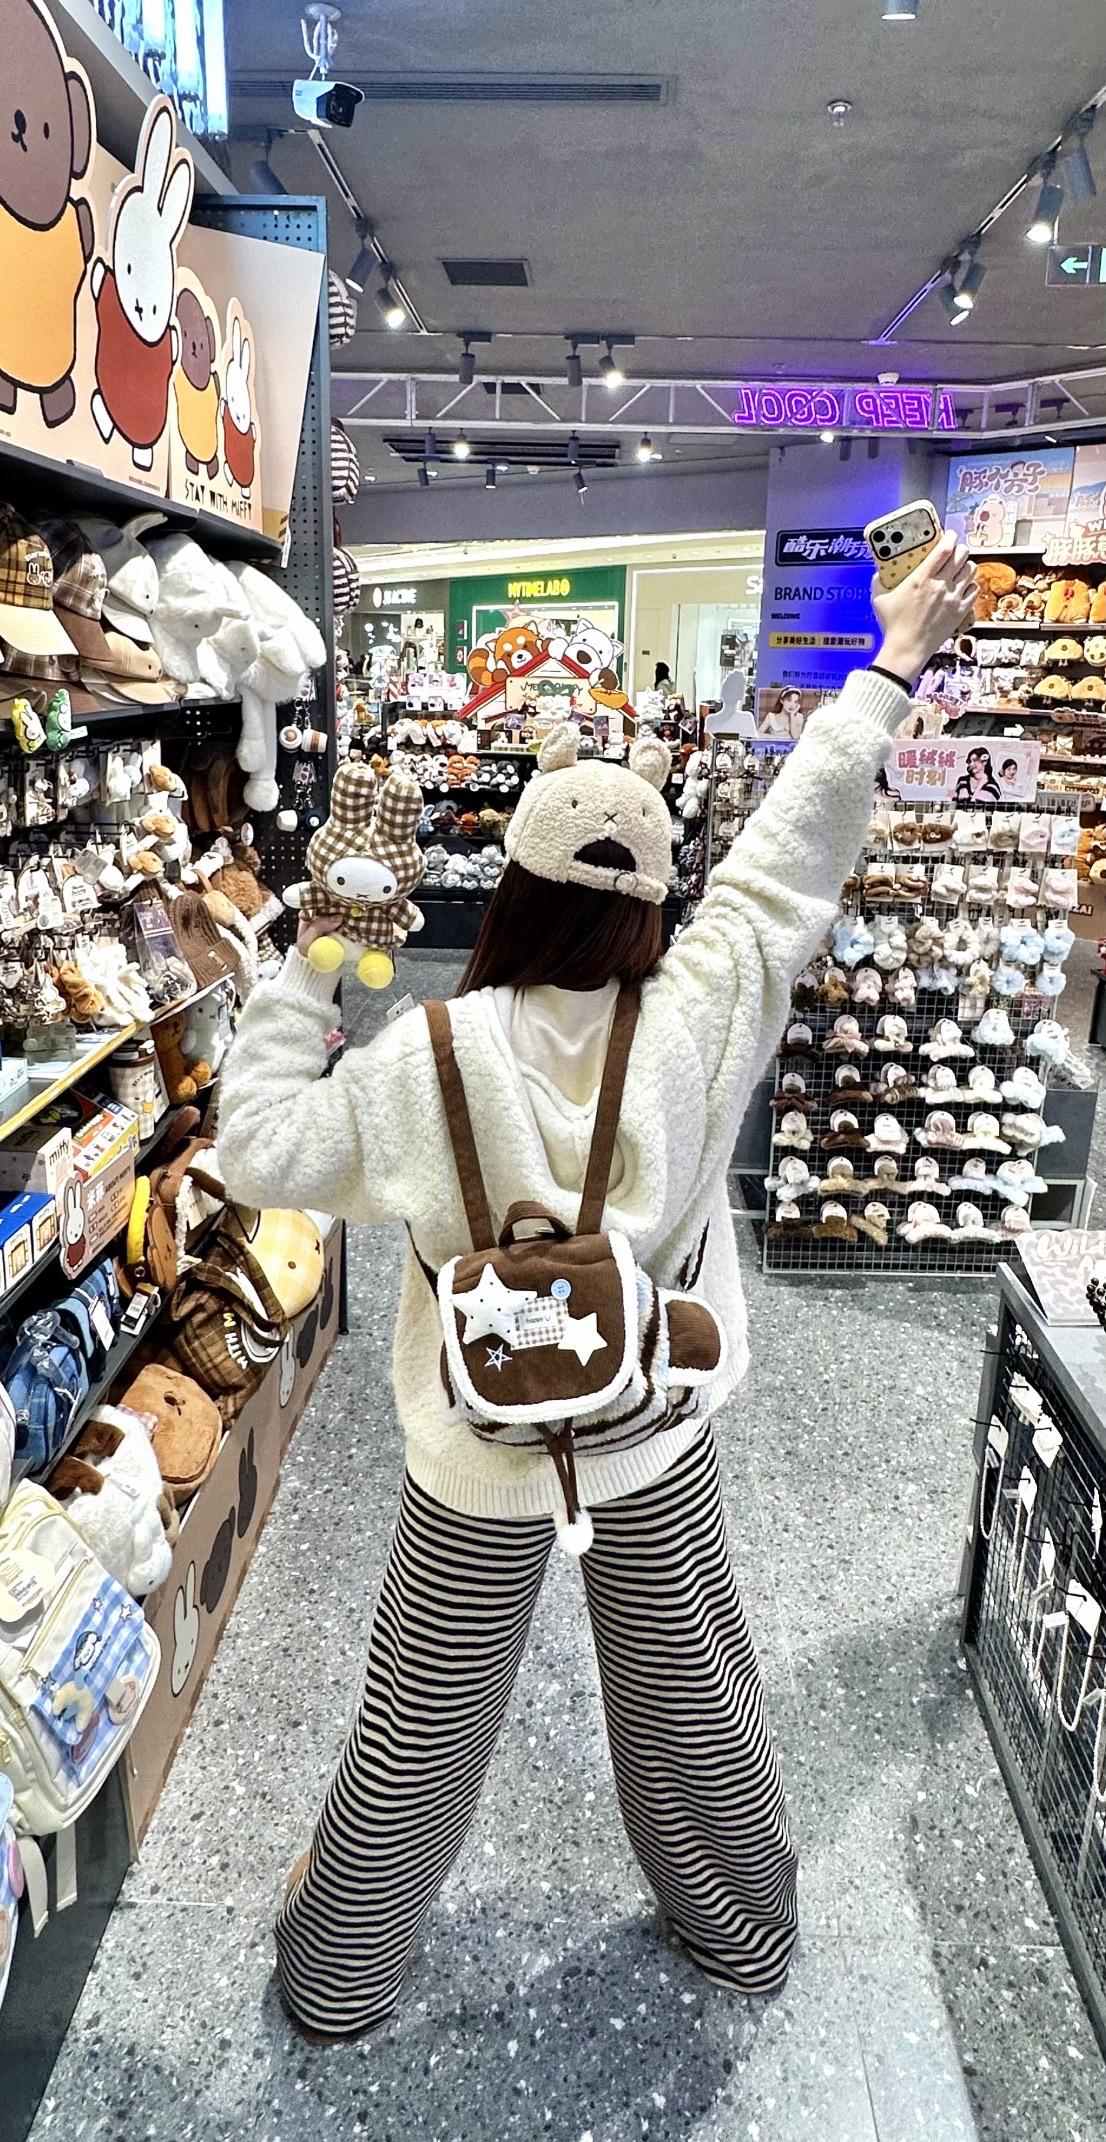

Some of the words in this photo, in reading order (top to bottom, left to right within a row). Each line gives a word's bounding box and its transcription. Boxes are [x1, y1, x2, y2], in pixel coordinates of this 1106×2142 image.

[185, 479, 205, 504] STAY
[209, 490, 229, 513] WITH
[774, 587, 824, 600] BRAND
[906, 768, 946, 787] 时刻
